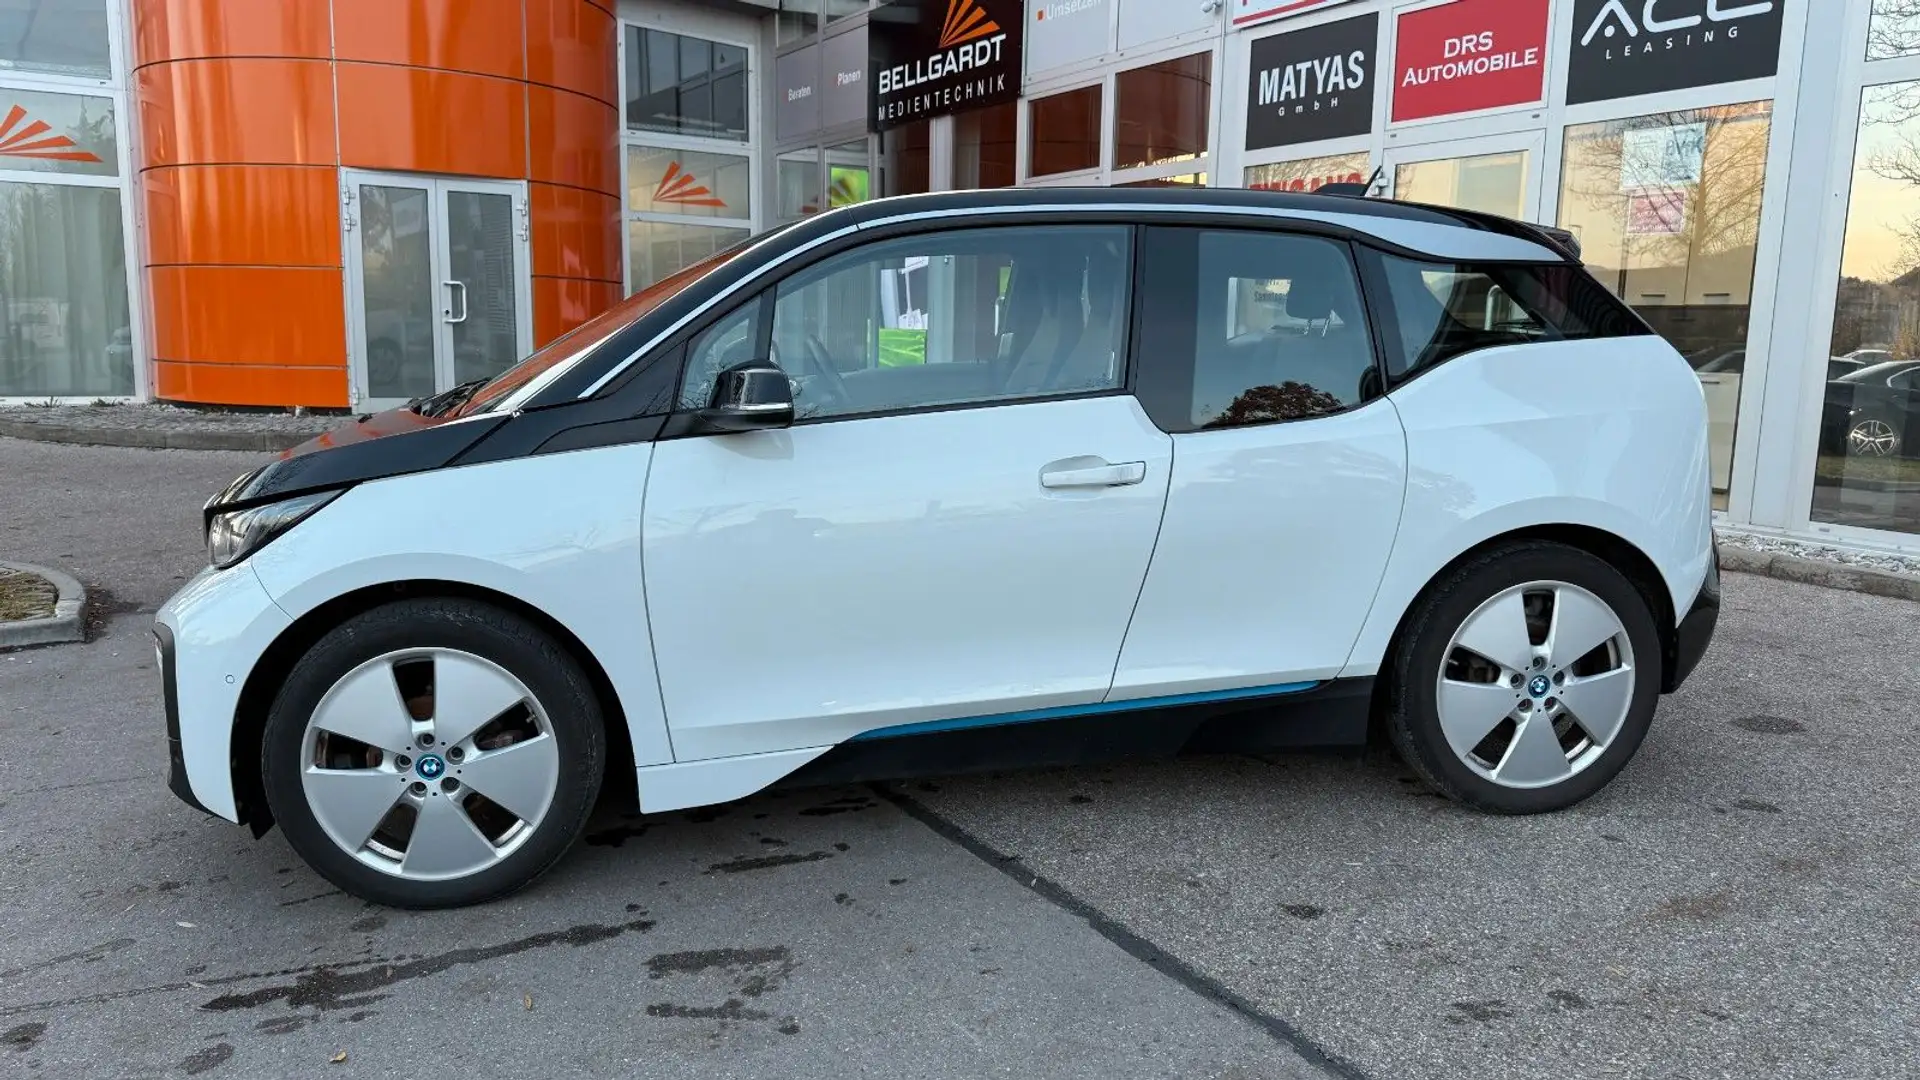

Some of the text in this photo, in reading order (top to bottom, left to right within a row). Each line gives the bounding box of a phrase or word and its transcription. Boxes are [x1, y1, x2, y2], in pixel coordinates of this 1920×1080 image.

[1443, 31, 1493, 58] DRS
[1605, 26, 1738, 60] LEASING
[837, 70, 861, 86] Planen
[879, 33, 1006, 94] BELLGARDT
[1258, 50, 1365, 106] MATYAS
[1401, 46, 1539, 88] AUTOMOBILE
[788, 86, 812, 102] Beraten
[878, 73, 1005, 121] MEDIENTECHNIK
[1278, 97, 1338, 117] GmbH
